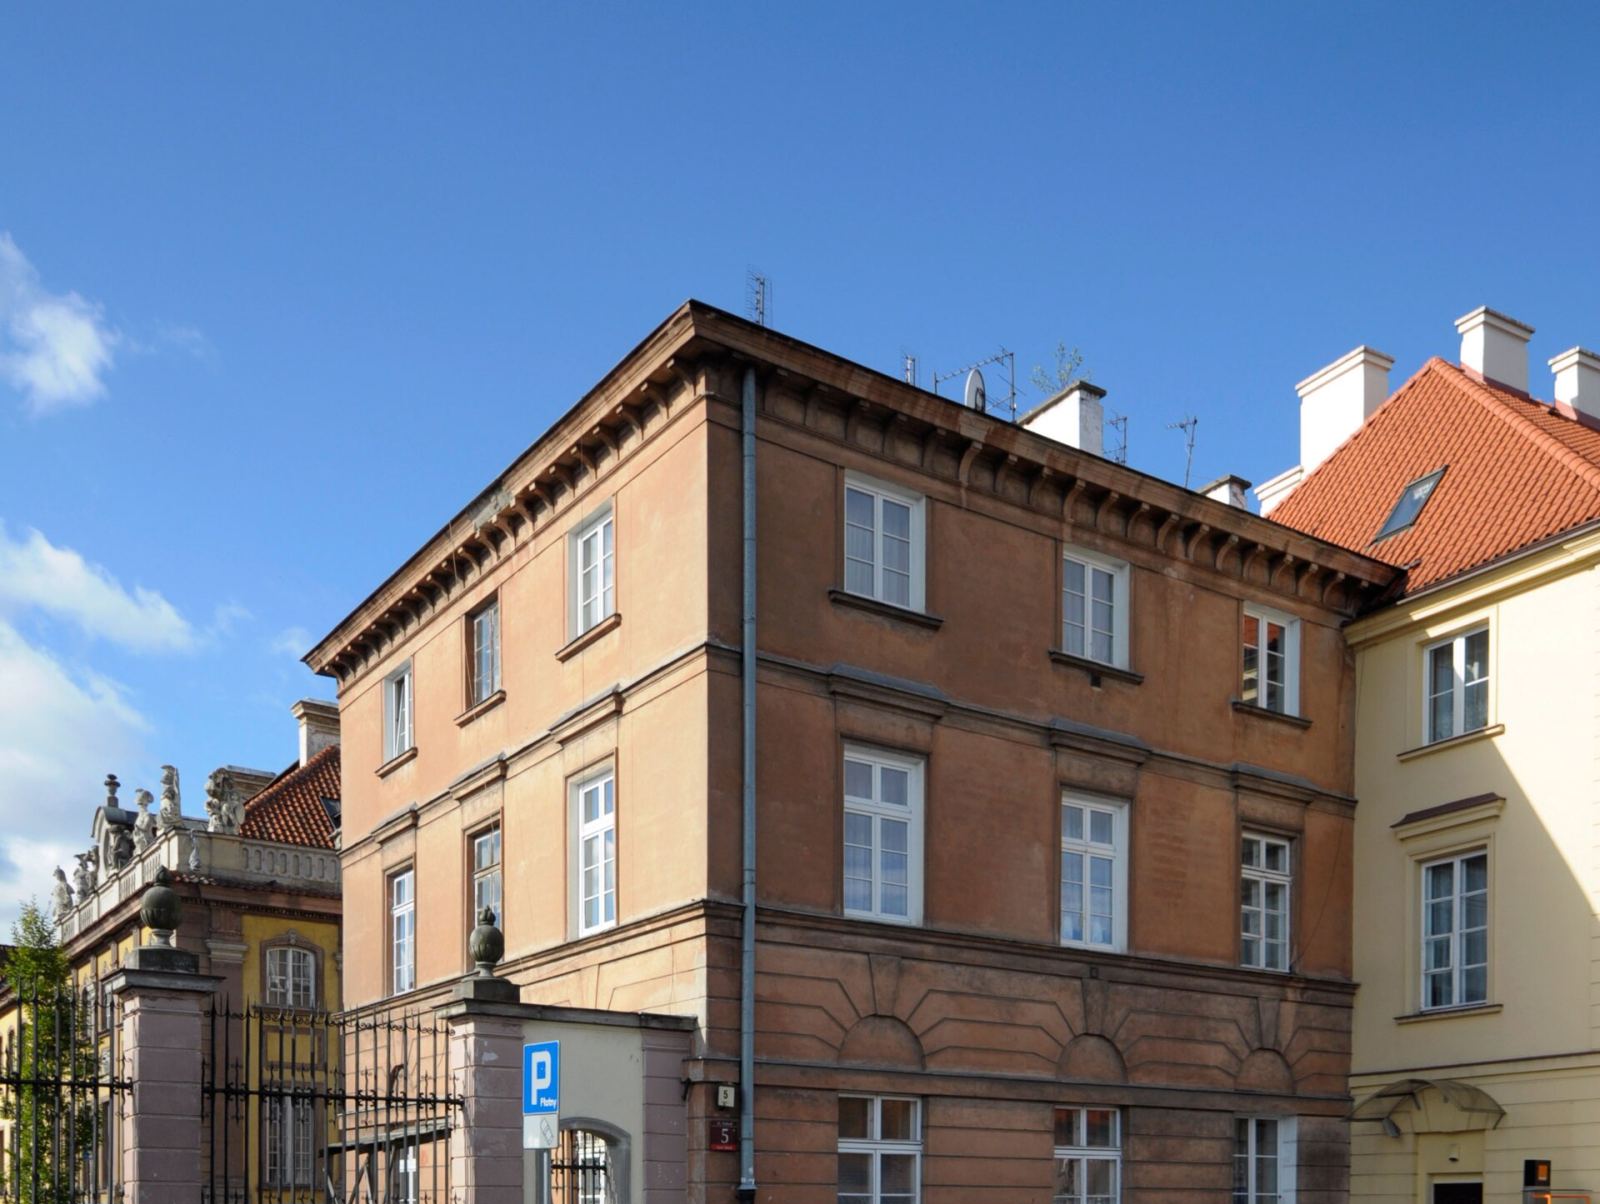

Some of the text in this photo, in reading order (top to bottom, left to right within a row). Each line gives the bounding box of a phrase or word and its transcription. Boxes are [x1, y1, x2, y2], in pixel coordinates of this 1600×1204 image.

[531, 1051, 551, 1105] P
[723, 1090, 729, 1100] 5
[720, 1128, 729, 1144] 5
